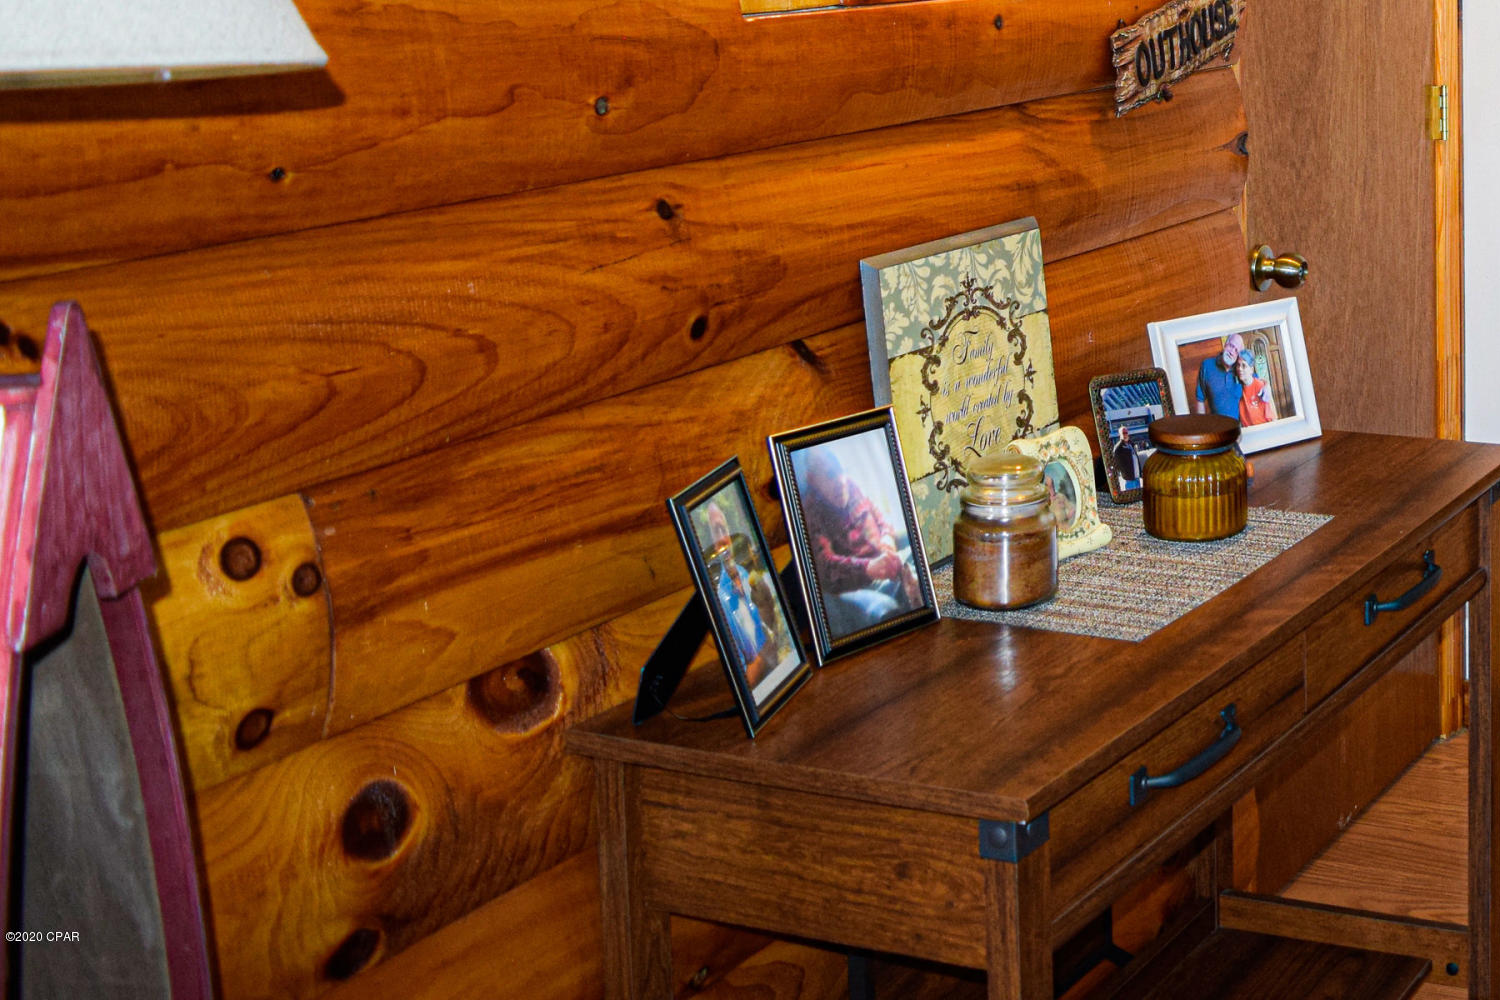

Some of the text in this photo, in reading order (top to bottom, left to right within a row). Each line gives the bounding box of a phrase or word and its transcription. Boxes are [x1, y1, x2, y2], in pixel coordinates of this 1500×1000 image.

[952, 330, 994, 365] Family
[942, 353, 1012, 398] is a wonderful
[945, 382, 1014, 424] world created by
[964, 415, 1001, 458] Love
